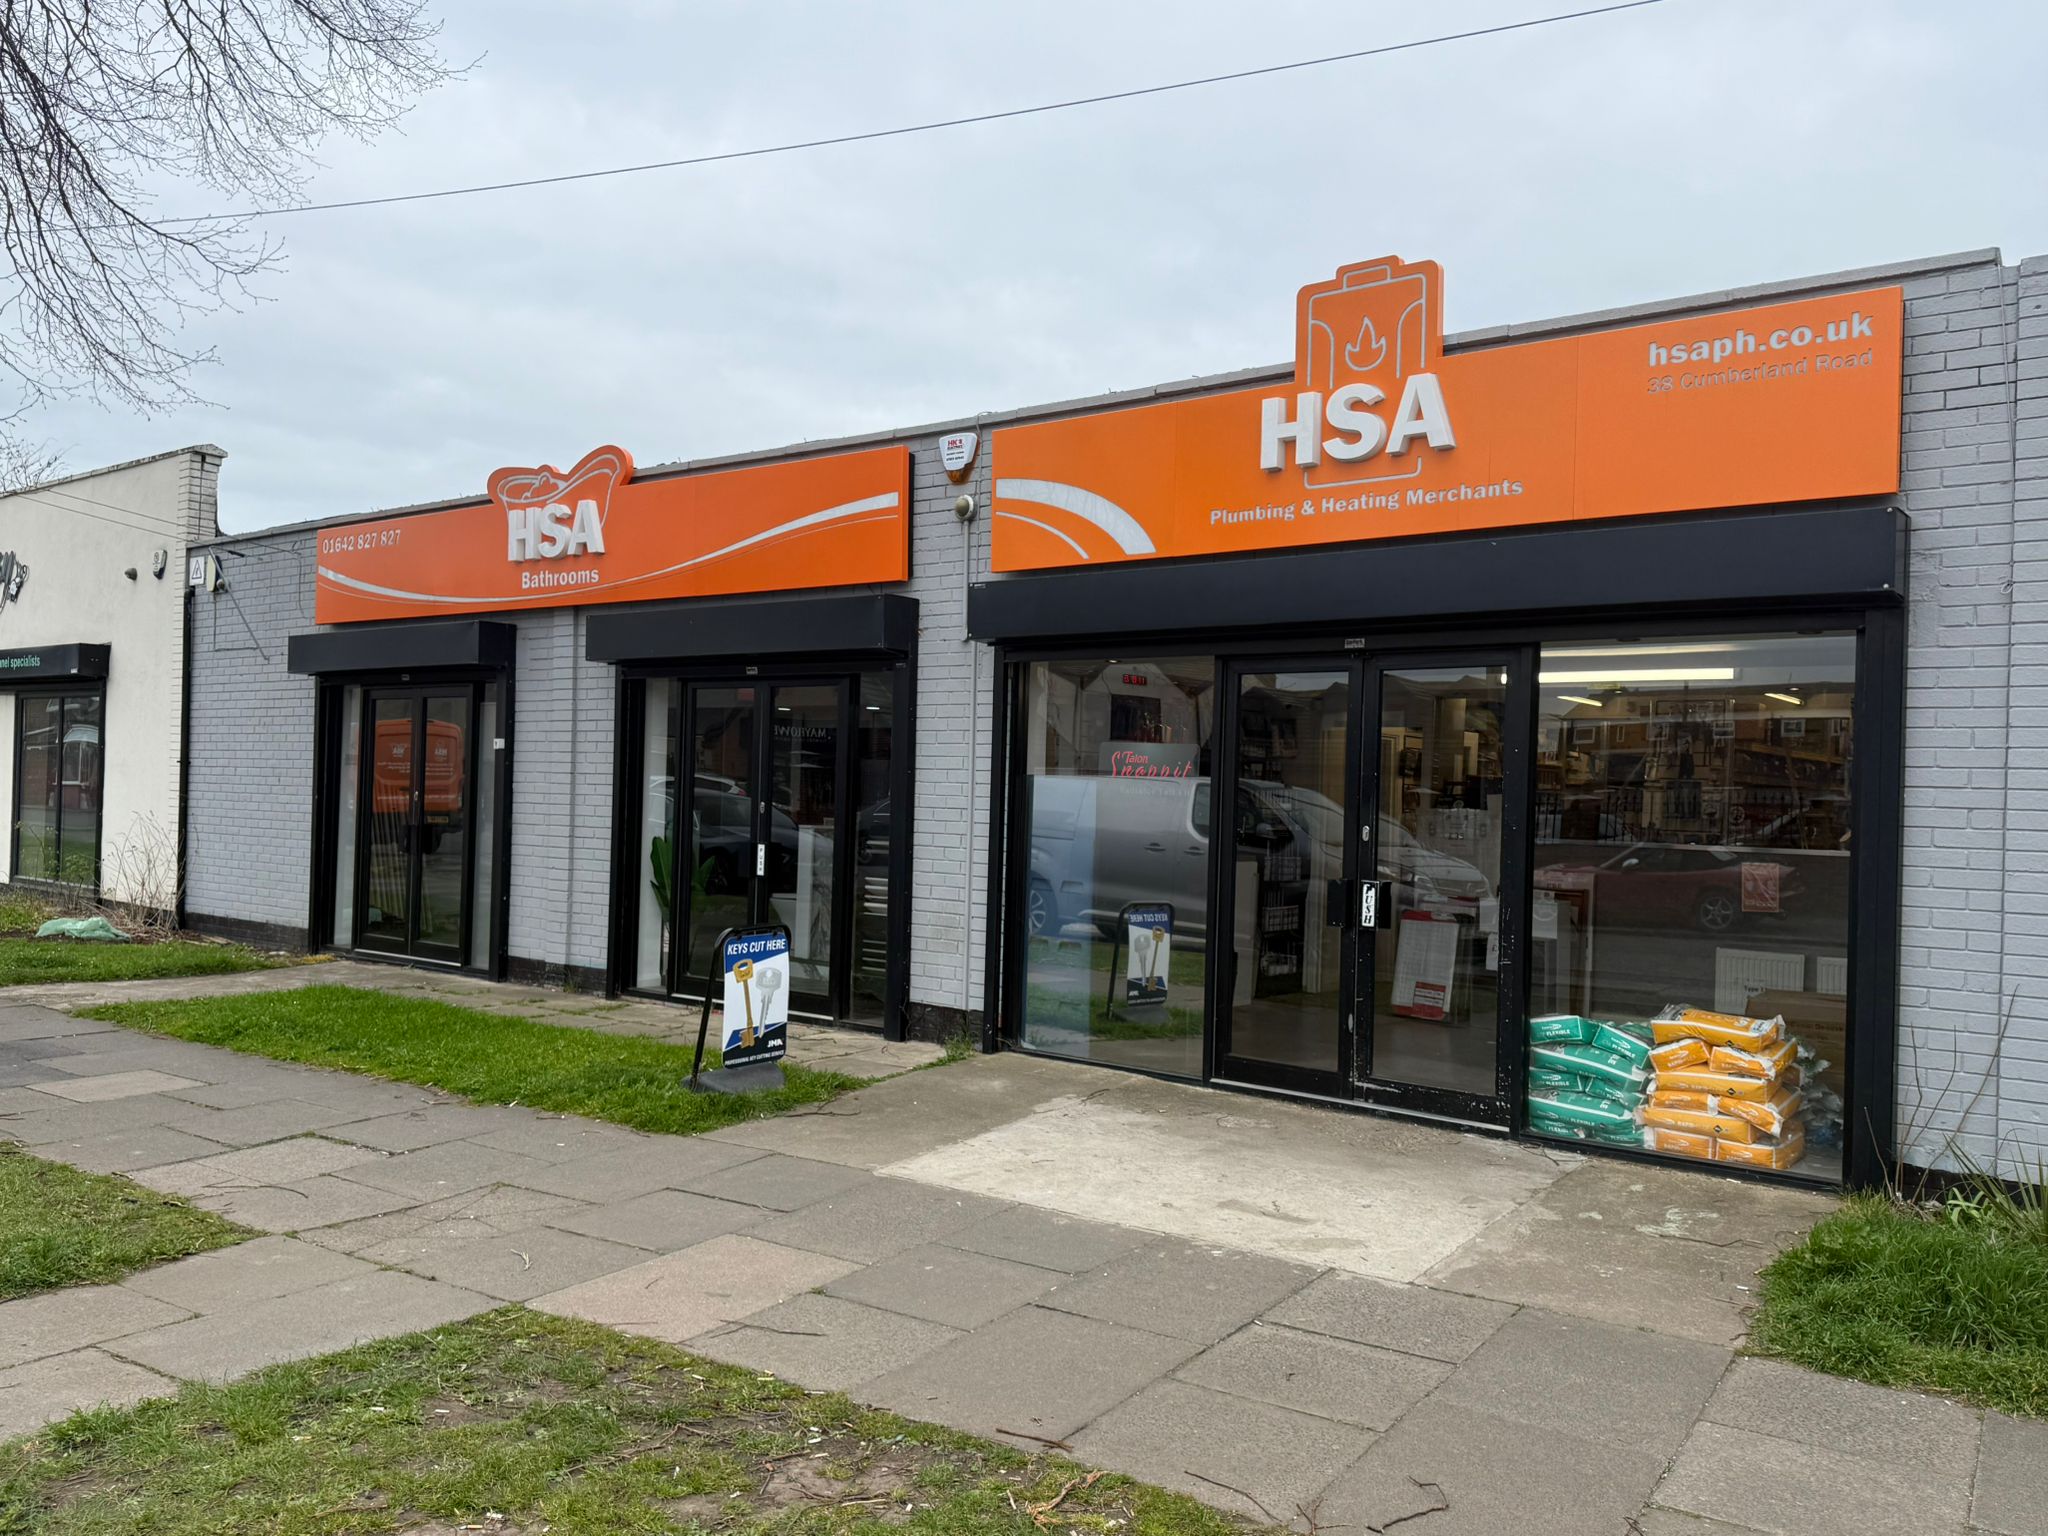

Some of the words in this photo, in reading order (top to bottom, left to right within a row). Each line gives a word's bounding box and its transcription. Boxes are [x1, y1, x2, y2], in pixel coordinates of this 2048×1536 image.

[1648, 310, 1874, 367] hsaph.co.uk
[1647, 374, 1674, 394] 38
[1680, 357, 1808, 390] Cumberland
[1815, 348, 1873, 372] Road
[1260, 372, 1457, 472] HSA
[1210, 503, 1295, 525] Plumbing
[1301, 500, 1315, 515] &
[1321, 490, 1400, 513] Heating
[1406, 479, 1524, 505] Merchants
[322, 536, 355, 554] 01642
[357, 532, 378, 550] 827
[380, 529, 401, 546] 827
[507, 499, 606, 563] HSA
[521, 569, 600, 589] Bathrooms
[10, 654, 40, 670] specialists
[1122, 751, 1149, 764] Talon
[727, 942, 748, 955] KEYS
[749, 940, 766, 953] CUT
[766, 939, 786, 951] HERE
